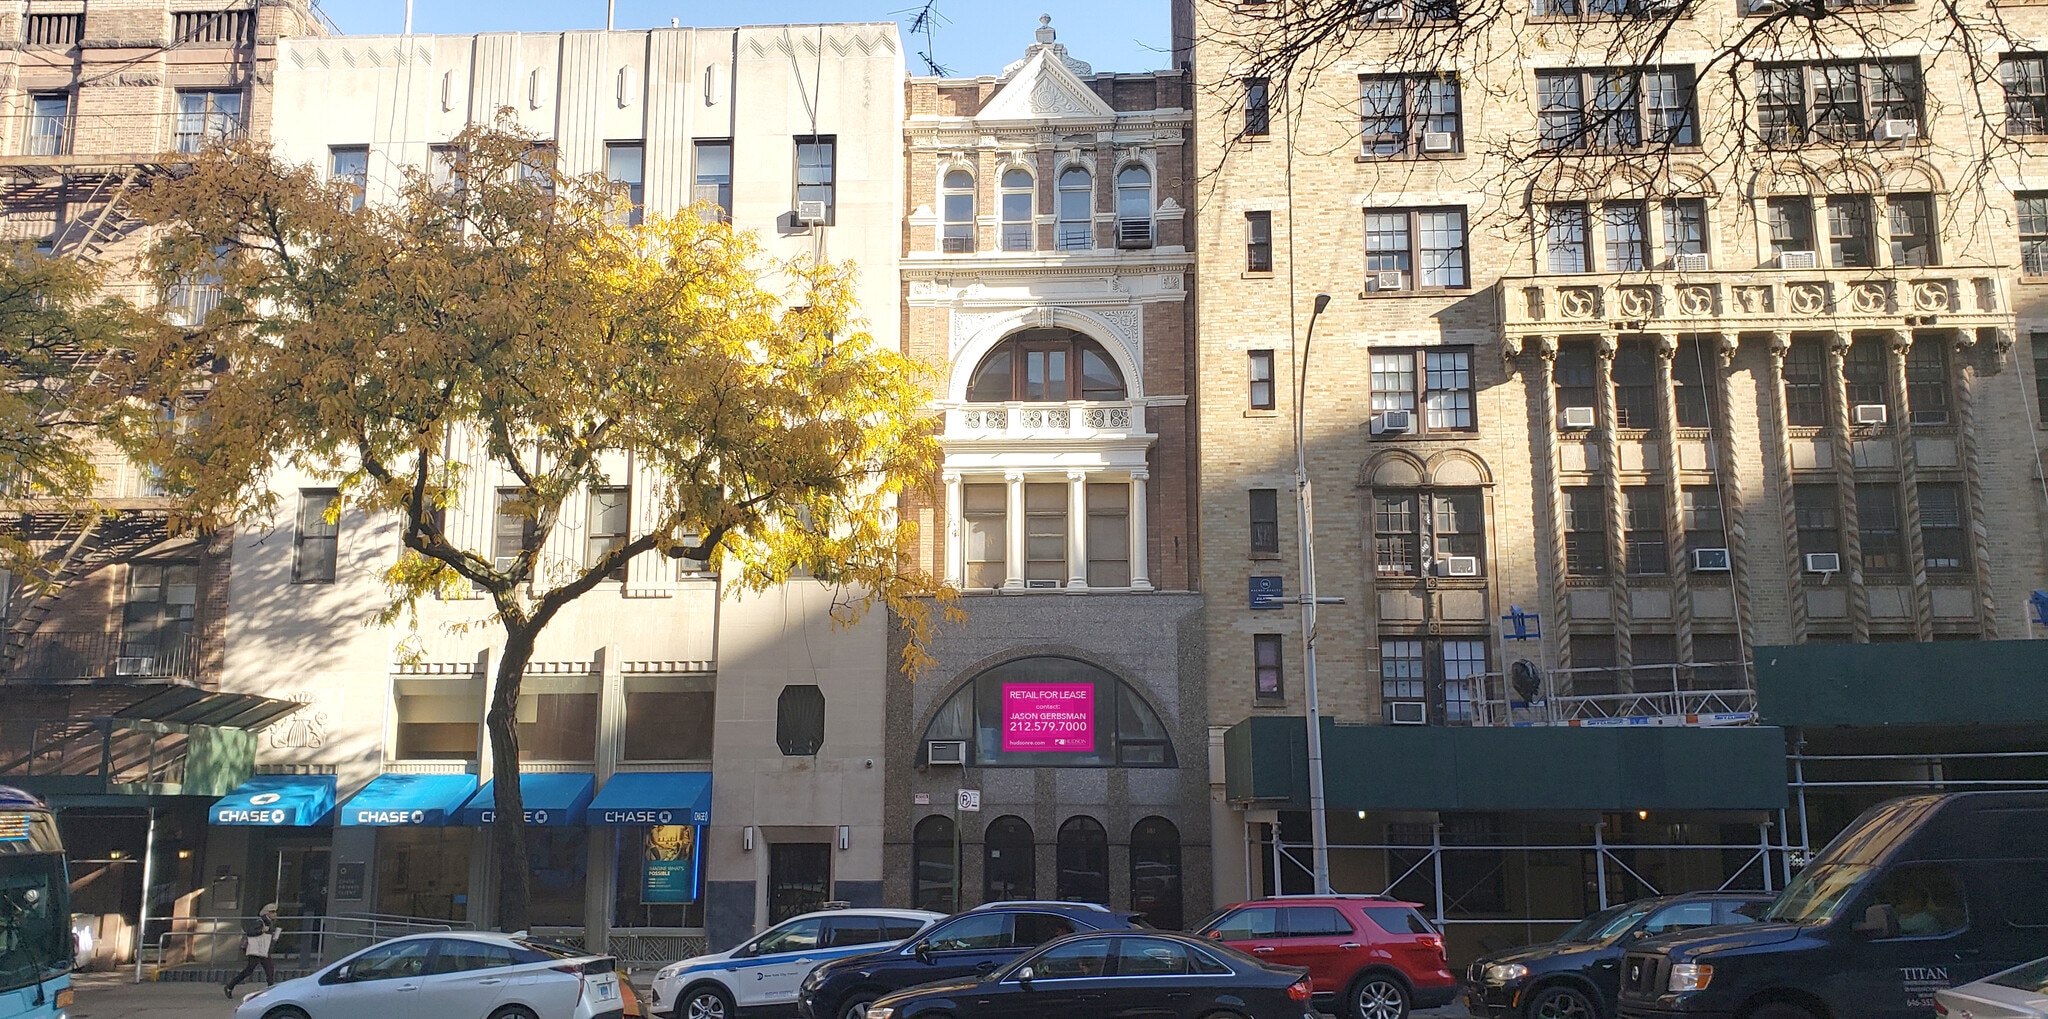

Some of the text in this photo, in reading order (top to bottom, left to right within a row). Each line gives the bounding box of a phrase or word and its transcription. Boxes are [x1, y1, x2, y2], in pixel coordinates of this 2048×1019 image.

[1010, 691, 1086, 699] RETAIL FOR LEASE
[1010, 721, 1087, 731] 212.579.7000
[218, 810, 269, 823] CHASE
[358, 811, 409, 823] CHASE
[605, 811, 656, 823] CHASE
[1900, 967, 1949, 980] TITAN
